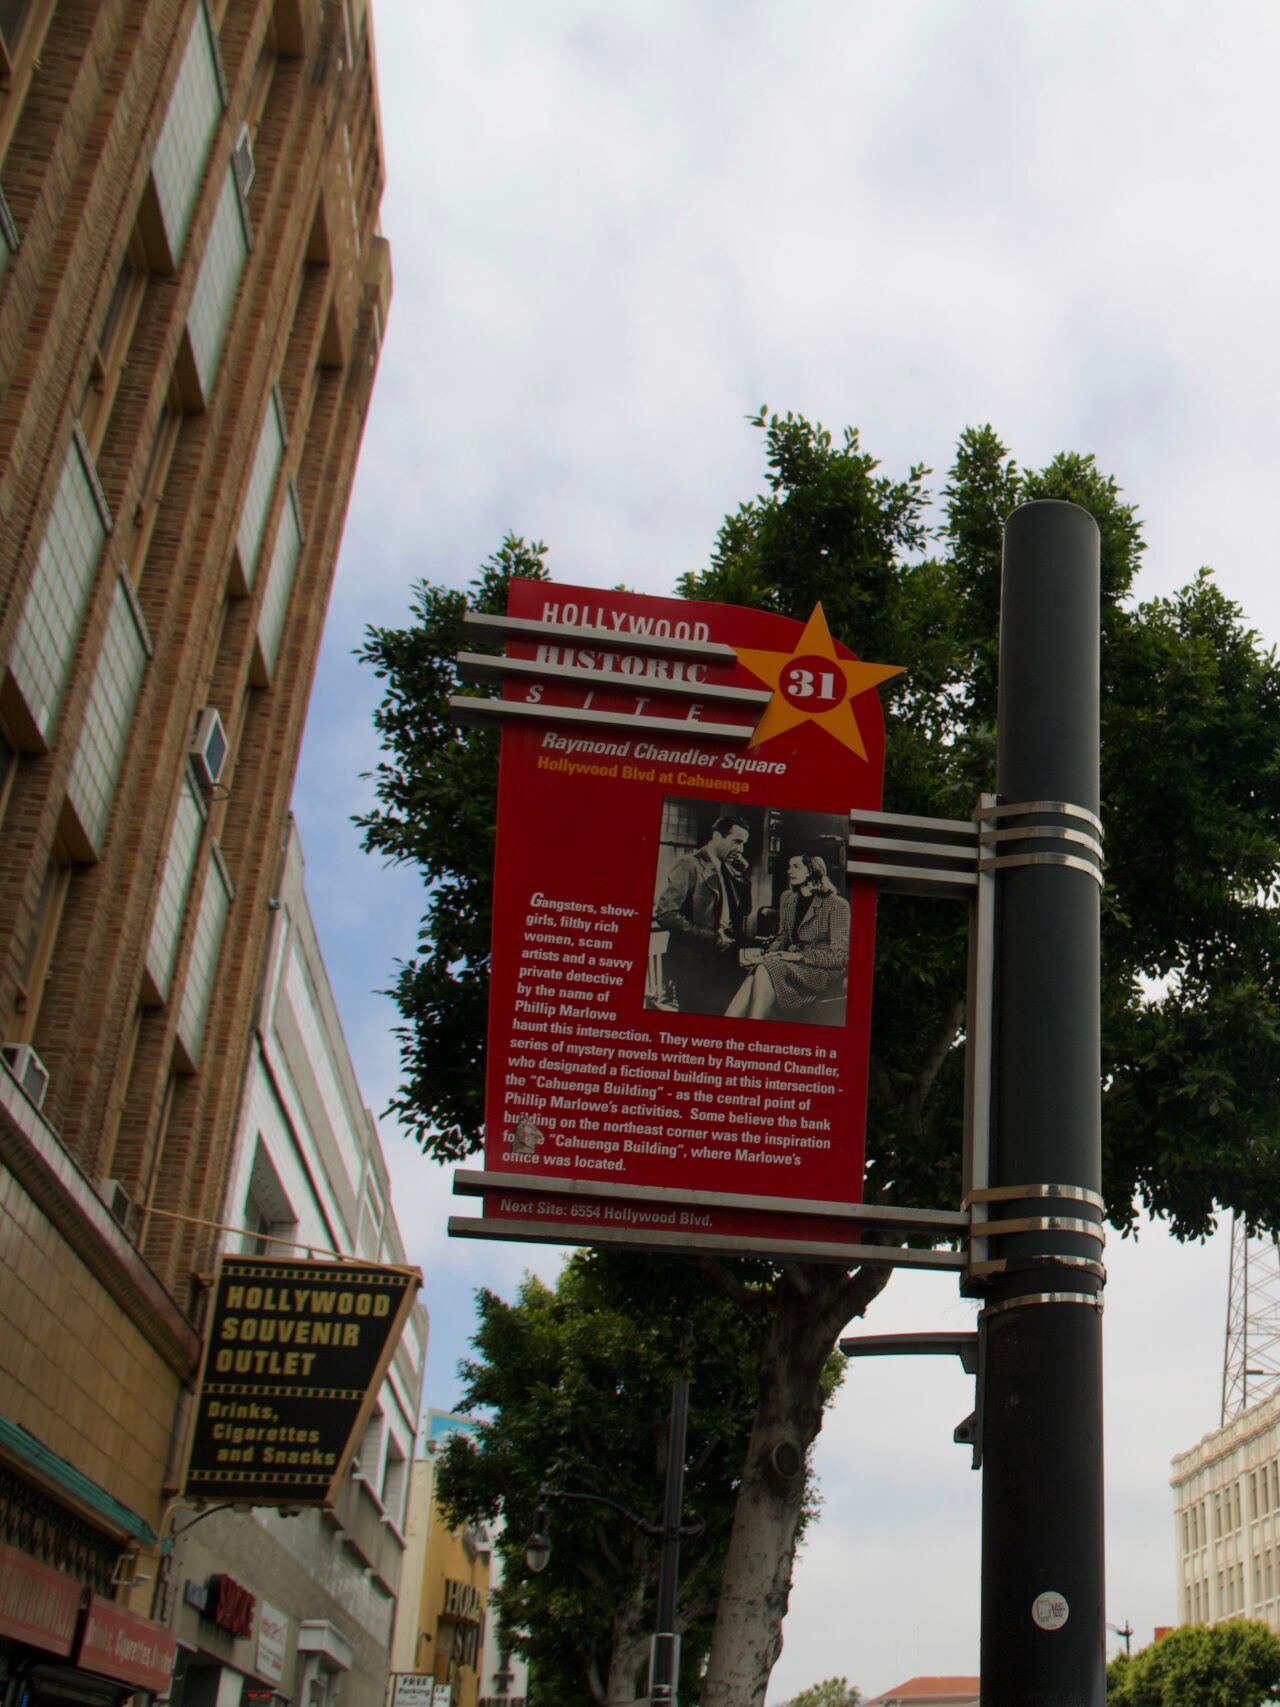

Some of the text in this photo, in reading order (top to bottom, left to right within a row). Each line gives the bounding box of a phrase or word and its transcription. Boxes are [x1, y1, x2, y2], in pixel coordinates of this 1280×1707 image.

[542, 602, 709, 642] HOLLYWOOD
[535, 644, 707, 685] HISTORIC
[788, 669, 836, 700] 31
[542, 732, 786, 774] Raymond Chandler Square
[538, 756, 749, 794] Hollywood Blvd at Cahuenga
[530, 892, 638, 917] Gangsters, show-
[526, 913, 618, 932] girls, filthy rich
[524, 932, 612, 950] women, scam
[522, 948, 633, 971] artists and a savvy
[519, 966, 623, 986] private detective
[517, 982, 610, 1002] by the name of
[515, 1000, 616, 1020] Phillip Marlowe
[512, 1018, 836, 1058] haunt this intersection. They were the characters in a
[510, 1038, 839, 1078] series of mystery novels written by Raymond Chandler,
[508, 1056, 536, 1068] who
[539, 1058, 606, 1074] designated
[610, 1067, 617, 1076] a
[620, 1065, 670, 1080] fictional
[674, 1070, 722, 1088] building
[725, 1076, 737, 1086] at
[739, 1076, 762, 1088] this
[765, 1078, 835, 1094] intersection
[506, 1073, 526, 1086] the
[676, 1091, 690, 1100] as
[694, 1090, 713, 1102] the
[717, 1095, 760, 1106] central
[764, 1097, 795, 1110] point
[799, 1099, 811, 1110] of
[505, 1092, 546, 1109] Phillip
[621, 1104, 682, 1118] activities.
[690, 1108, 725, 1122] Some
[729, 1111, 774, 1126] believe
[778, 1116, 797, 1128] the
[801, 1117, 830, 1130] bank
[560, 1119, 576, 1129] on
[580, 1118, 600, 1130] the
[604, 1121, 663, 1136] northeast
[667, 1128, 708, 1139] corner
[712, 1132, 738, 1142] was
[741, 1131, 761, 1144] the
[765, 1132, 830, 1148] inspiration
[503, 1130, 517, 1142] fo
[549, 1133, 619, 1152] "Cahuenga
[623, 1140, 687, 1159] Building",
[691, 1146, 731, 1160] where
[735, 1149, 801, 1165] Marlowe's
[543, 1155, 571, 1166] was
[575, 1155, 626, 1171] located.
[500, 1199, 712, 1226] Next Site: 6554 Hollywood Blvd.
[226, 1285, 391, 1317] HOLLYWOOD
[221, 1317, 360, 1347] SOUVENIR
[216, 1349, 316, 1376] OUTLET
[208, 1401, 279, 1422] Drinks,
[213, 1423, 320, 1443] Cigarettes
[217, 1446, 336, 1465] and Snacks
[397, 1686, 431, 1697] Parking
[402, 1677, 429, 1686] FREE
